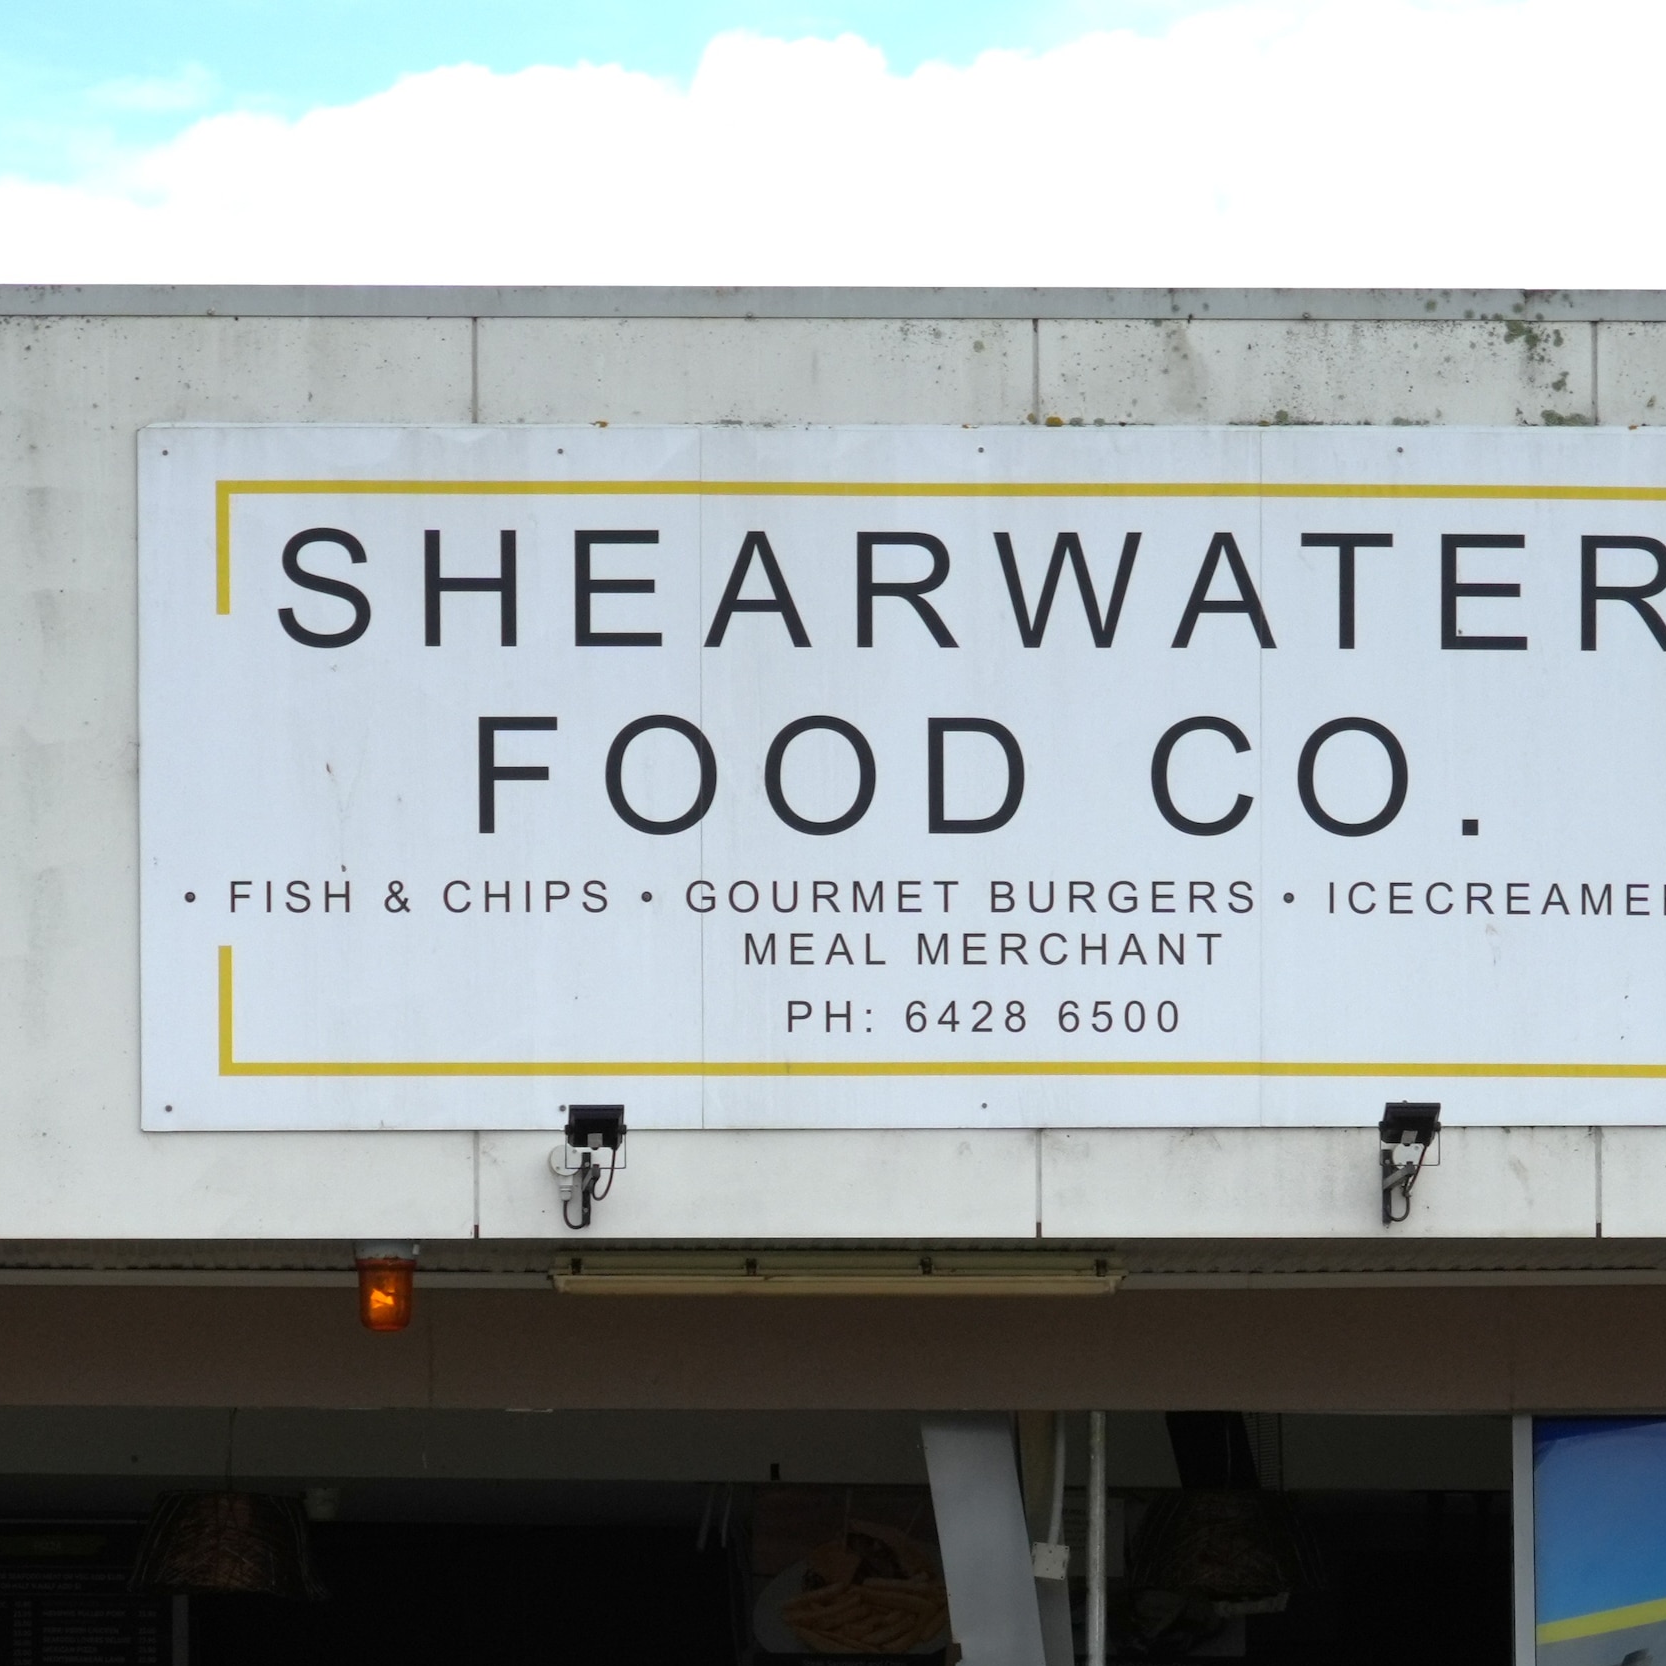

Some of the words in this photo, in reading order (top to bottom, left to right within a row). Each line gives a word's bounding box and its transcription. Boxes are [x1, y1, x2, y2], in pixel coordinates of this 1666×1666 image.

[478, 714, 1025, 836] FOOD
[1151, 715, 1479, 837] CO.
[230, 880, 350, 913] FISH
[384, 880, 411, 913] &
[443, 880, 608, 913] CHIPS
[686, 880, 959, 913] GOURMET
[991, 880, 1253, 914] BURGERS
[745, 933, 886, 965] MEAL
[918, 932, 1222, 966] MERCHANT
[788, 1000, 879, 1033] PH:
[905, 1000, 1026, 1033] 6428
[1058, 1000, 1178, 1033] 6500
